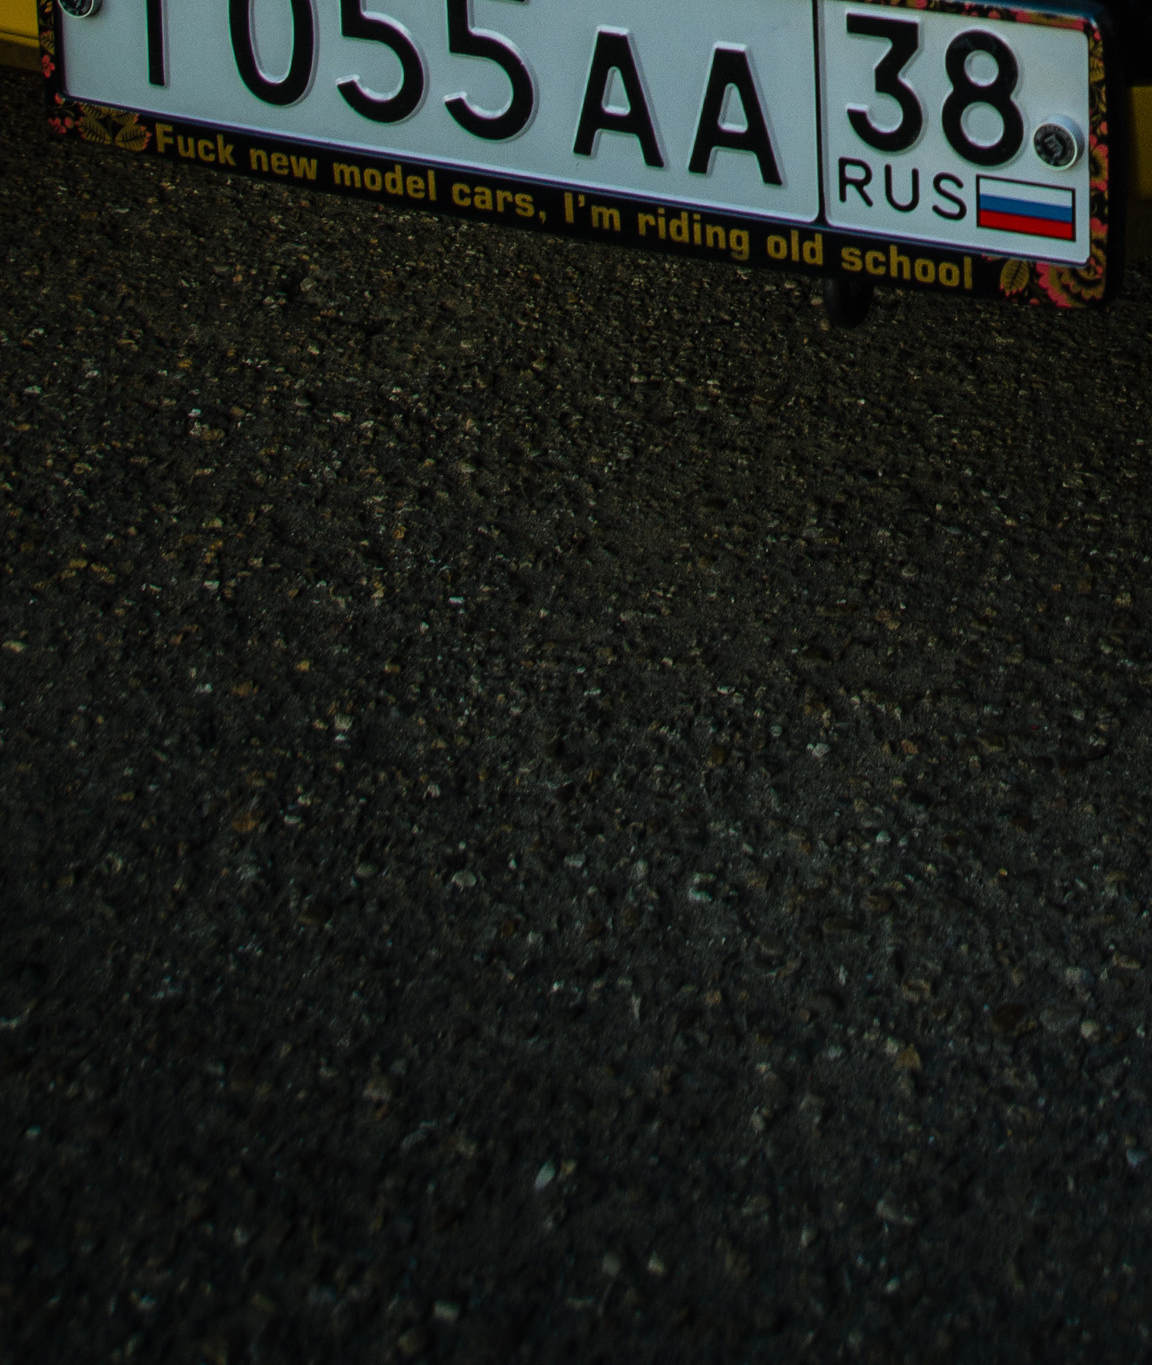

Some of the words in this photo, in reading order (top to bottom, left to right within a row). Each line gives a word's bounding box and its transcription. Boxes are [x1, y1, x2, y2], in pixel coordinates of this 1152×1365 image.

[846, 11, 1025, 167] 38
[155, 124, 236, 166] Fuck
[249, 148, 318, 182] new
[333, 163, 437, 201] model
[452, 179, 549, 224] cars,
[564, 192, 621, 232] I'm
[638, 202, 750, 260] riding
[766, 231, 825, 265] old
[841, 244, 974, 289] school
[838, 156, 968, 221] RUS
